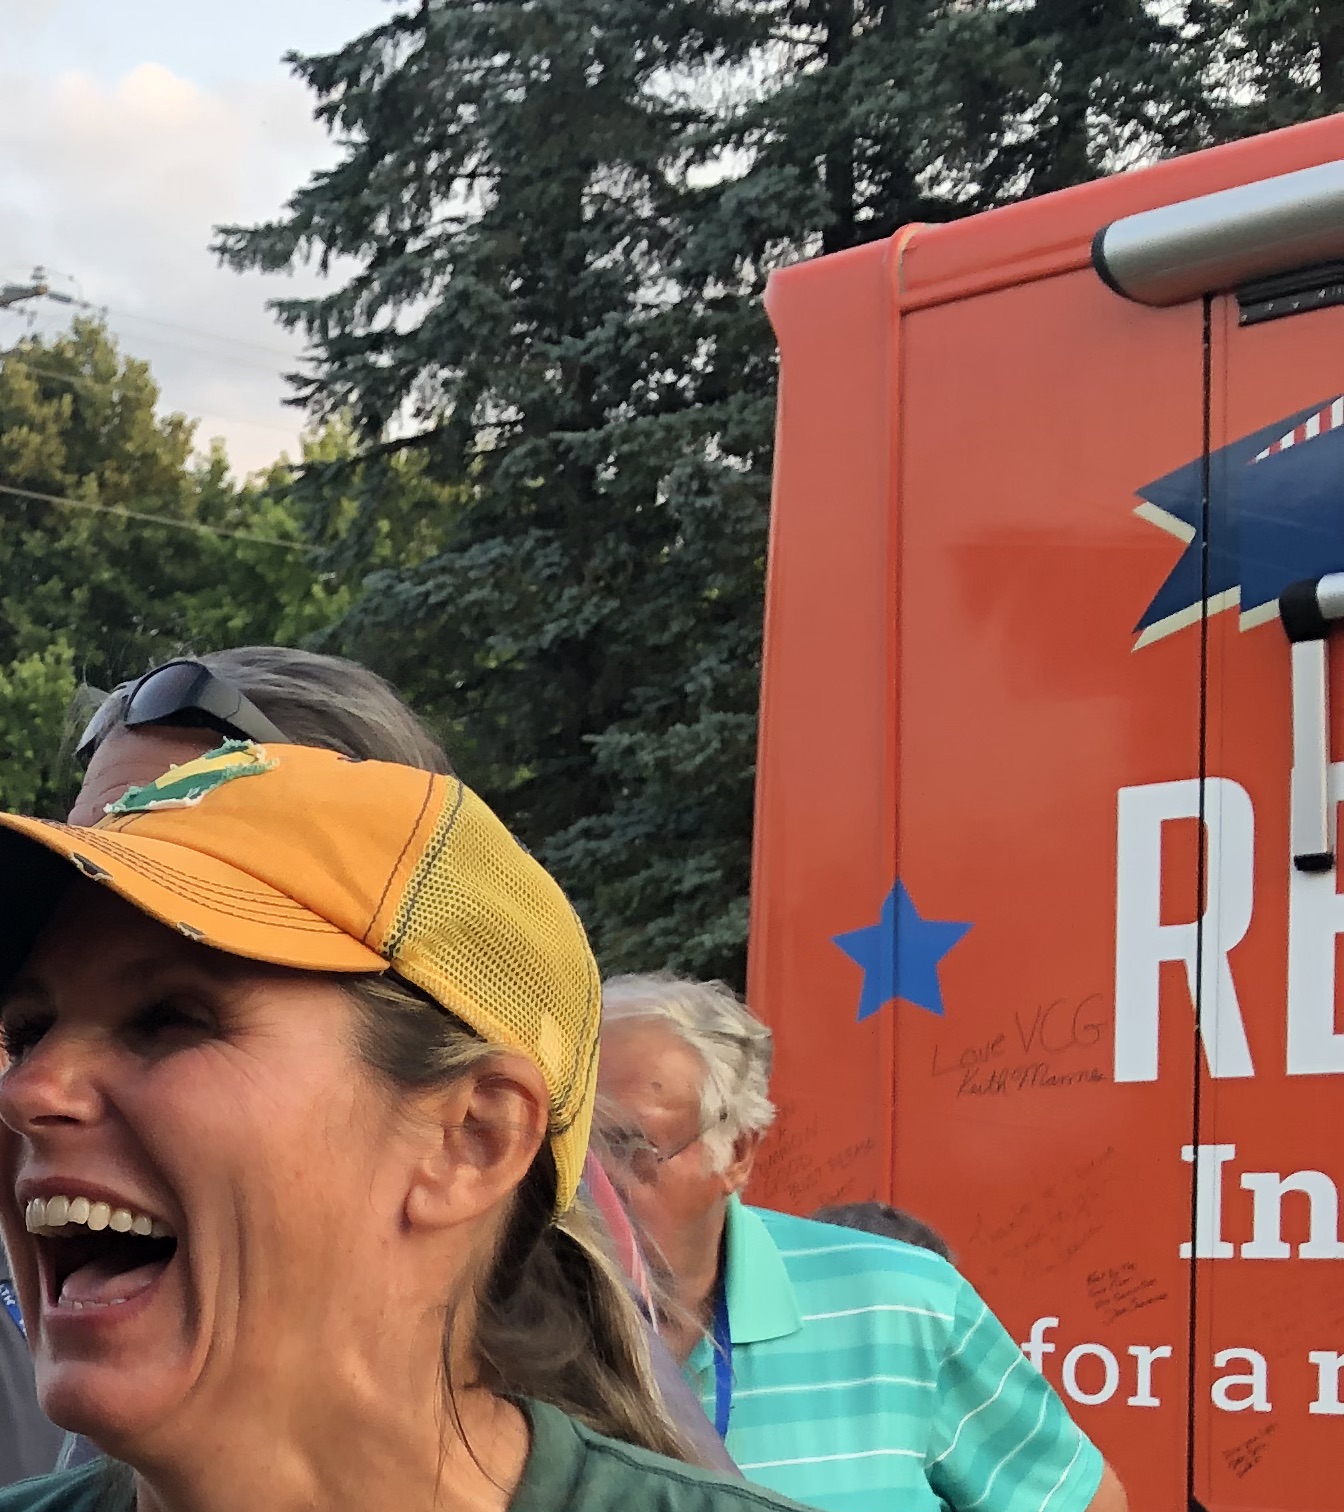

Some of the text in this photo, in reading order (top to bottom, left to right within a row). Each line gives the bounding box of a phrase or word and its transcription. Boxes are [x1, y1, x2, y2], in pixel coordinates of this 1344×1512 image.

[1179, 1144, 1344, 1259] In
[1021, 1317, 1173, 1407] for
[1211, 1348, 1273, 1412] a
